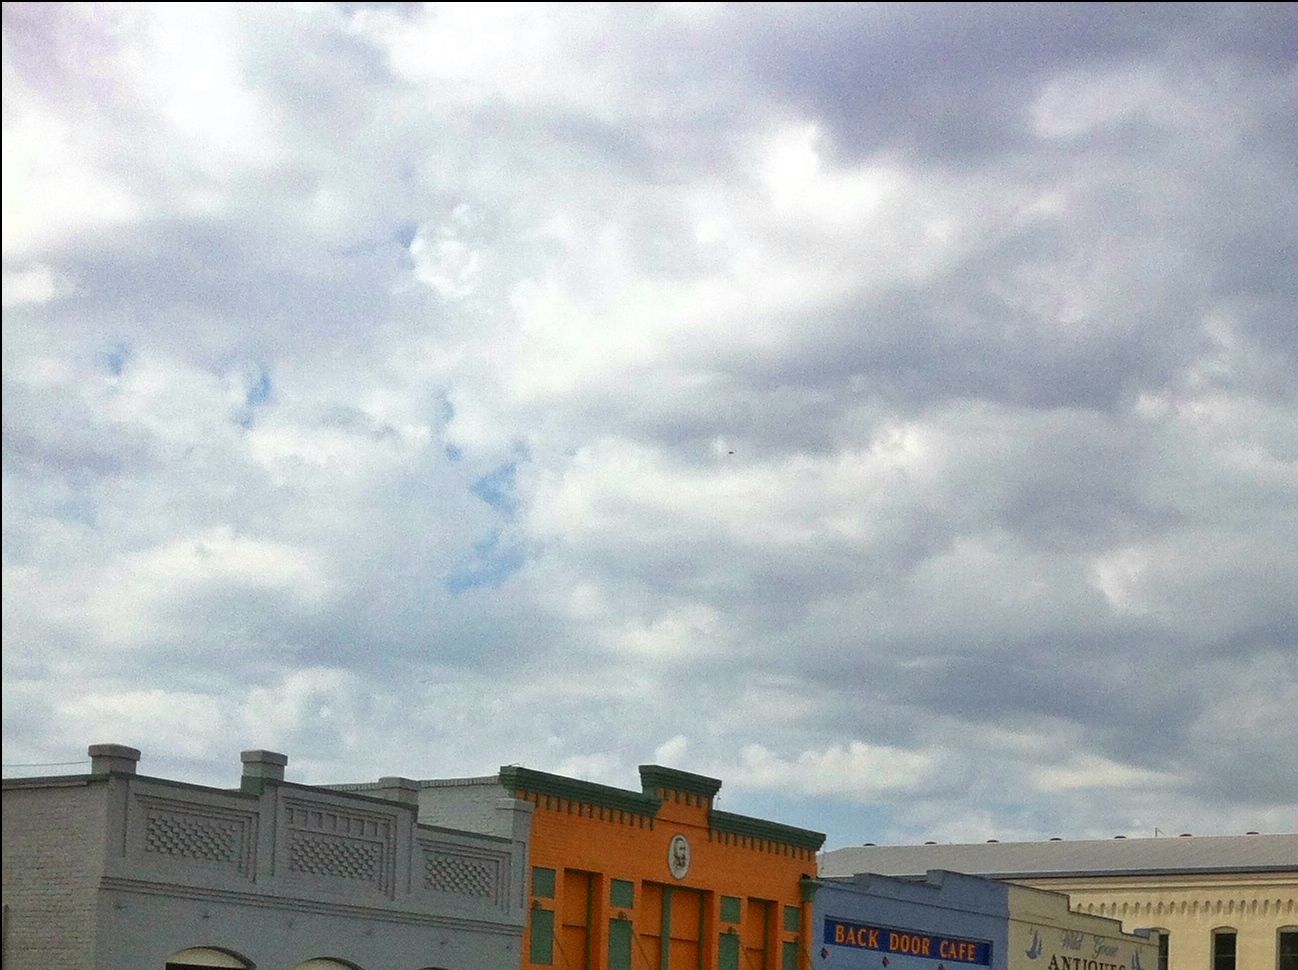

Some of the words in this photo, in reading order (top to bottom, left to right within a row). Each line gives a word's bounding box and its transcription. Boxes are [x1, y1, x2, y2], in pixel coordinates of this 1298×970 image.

[834, 923, 879, 949] BACK
[889, 932, 931, 957] DOOR
[939, 939, 976, 962] CAFE
